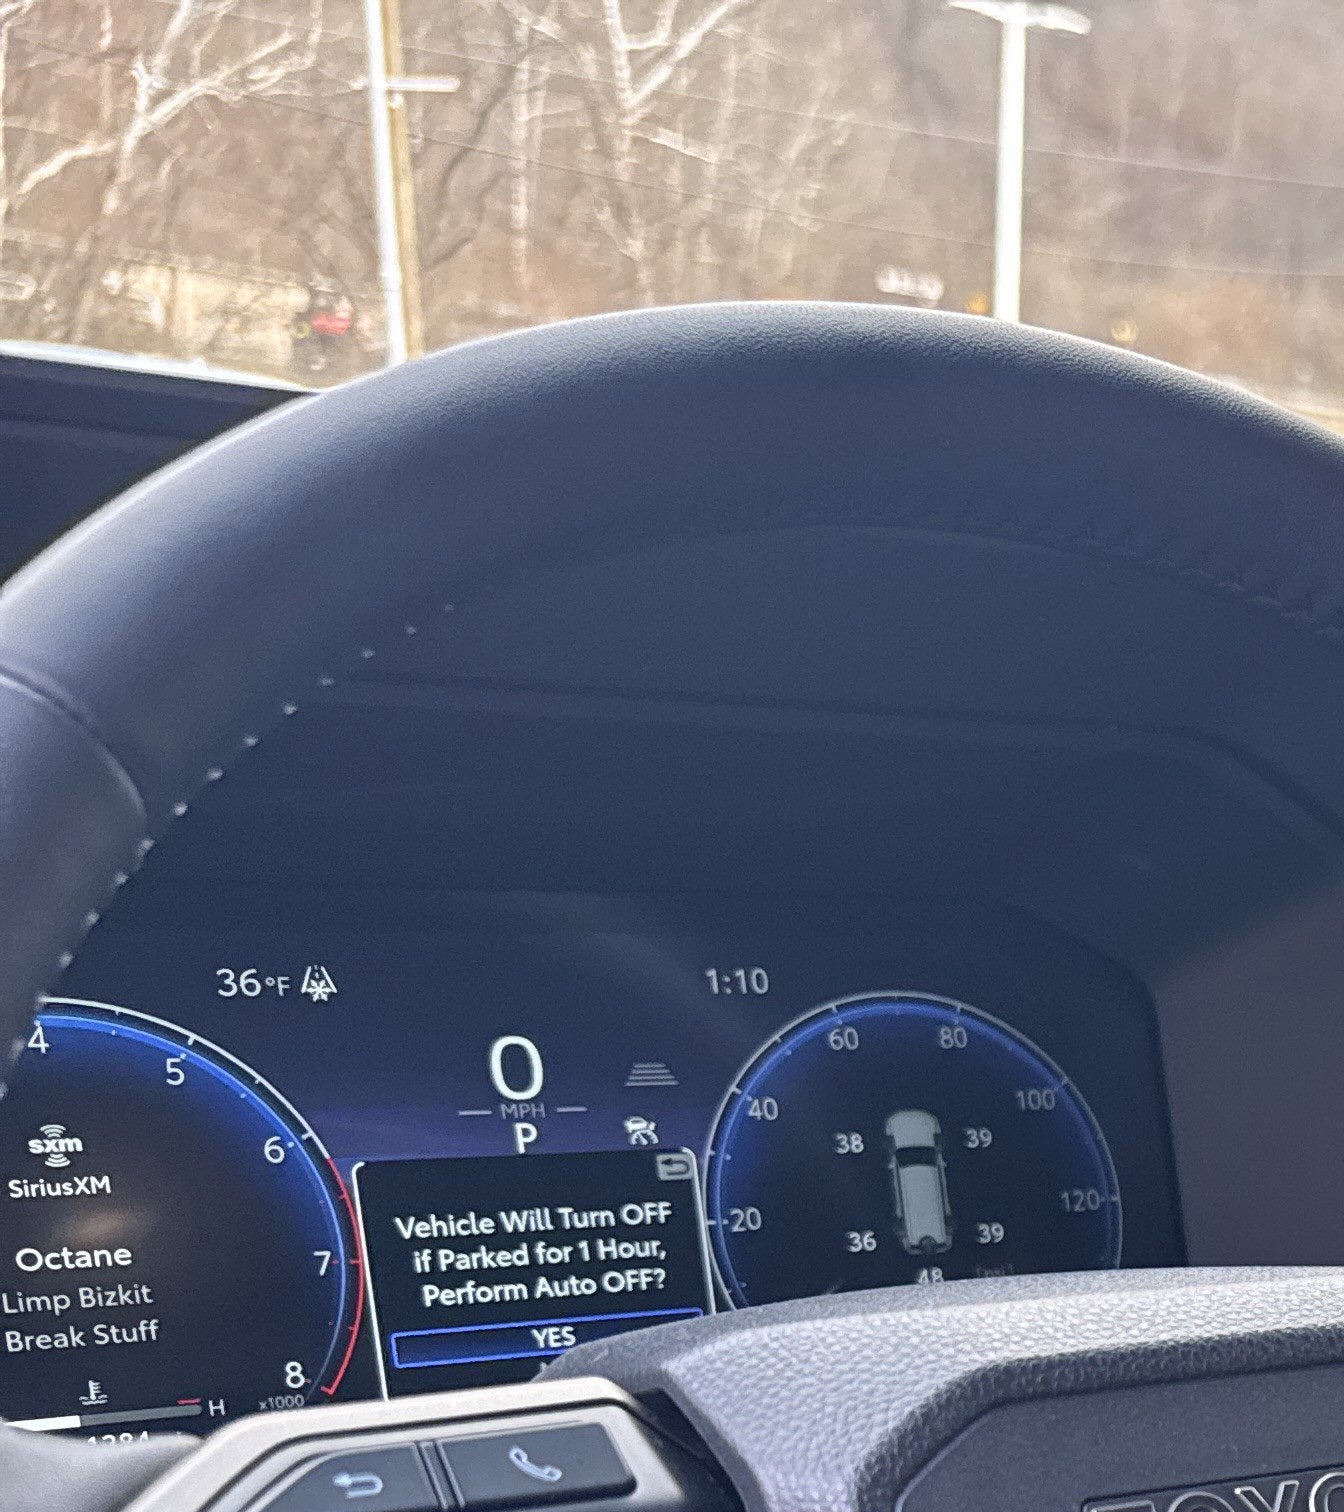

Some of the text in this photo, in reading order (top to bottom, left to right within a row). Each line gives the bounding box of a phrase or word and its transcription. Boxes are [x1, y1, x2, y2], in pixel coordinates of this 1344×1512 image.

[705, 967, 768, 995] 1:10
[27, 1026, 49, 1054] 4
[828, 1026, 859, 1051] 60
[939, 1025, 968, 1050] 80
[166, 1058, 185, 1085] 5
[488, 1035, 544, 1101] 0
[501, 1102, 546, 1120] MPH
[748, 1096, 779, 1122] 40
[1015, 1088, 1056, 1112] 100
[28, 1137, 83, 1155] sxm
[263, 1136, 285, 1163] 6
[516, 1123, 538, 1153] P
[834, 1132, 864, 1155] 38
[965, 1127, 993, 1150] 39
[8, 1175, 111, 1199] SiriusXM
[1061, 1188, 1100, 1213] 120
[394, 1201, 672, 1240] Vehicle Will Turn OFF
[731, 1207, 762, 1233] 20
[977, 1221, 1005, 1245] 39
[413, 1234, 668, 1275] if Parked for 1 Hour,
[846, 1230, 877, 1254] 36
[15, 1246, 133, 1272] Octane
[312, 1251, 332, 1275] 7
[1, 1284, 153, 1316] Limp Bizkit
[422, 1267, 666, 1308] Perform Auto OFF?
[5, 1319, 159, 1352] Break Stuff
[531, 1326, 577, 1349] YES
[284, 1361, 306, 1389] 8
[208, 1399, 226, 1417] H
